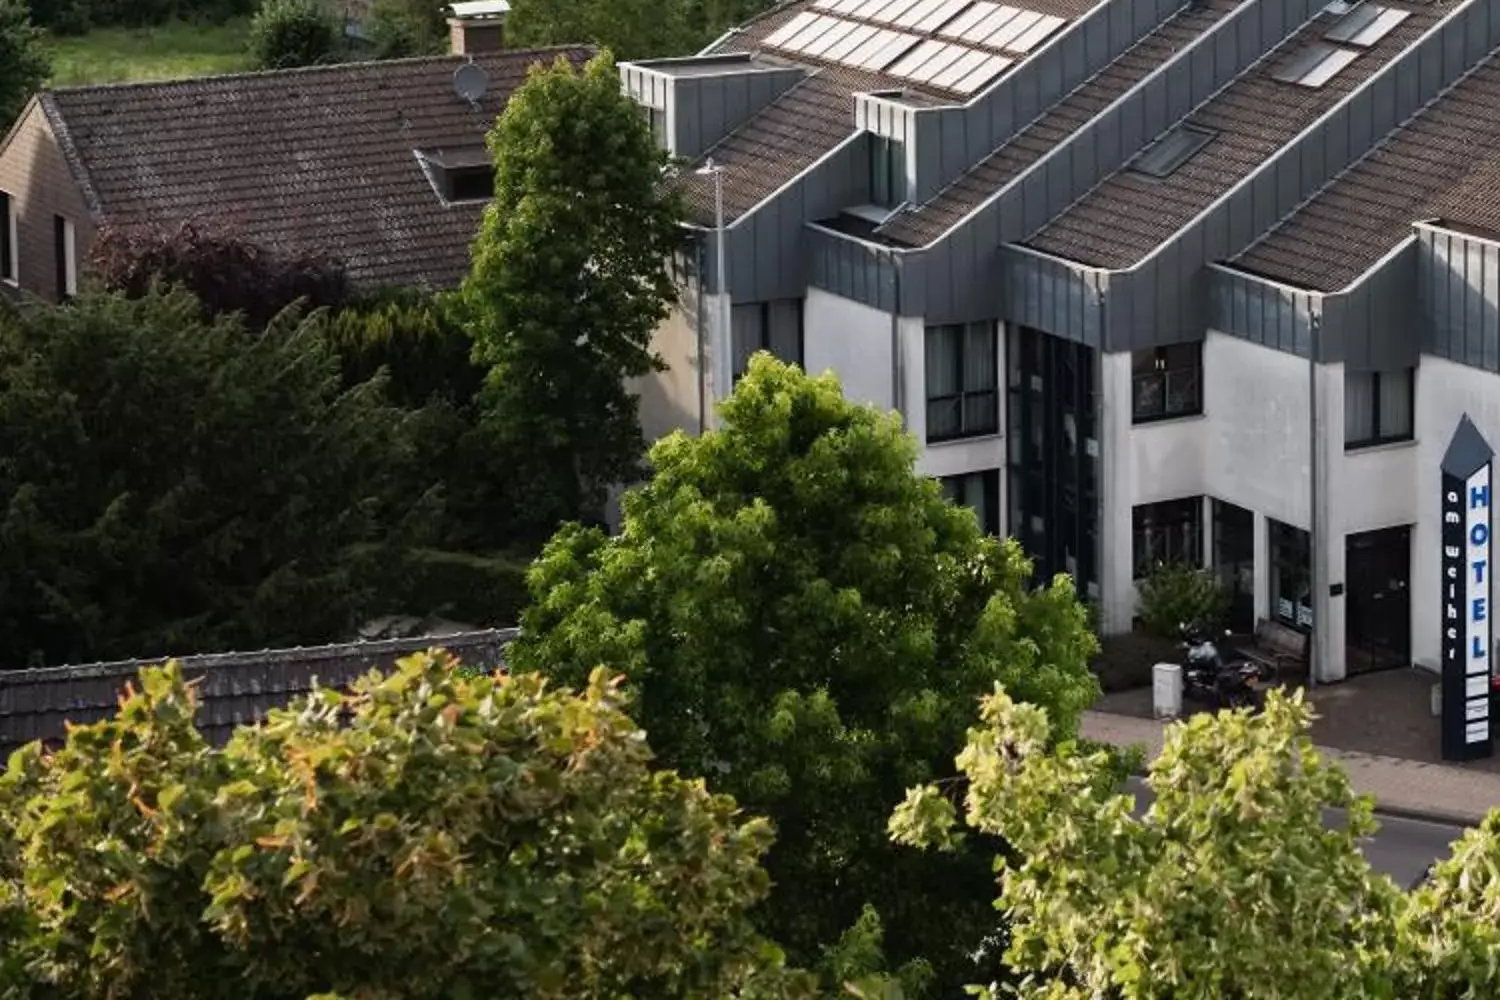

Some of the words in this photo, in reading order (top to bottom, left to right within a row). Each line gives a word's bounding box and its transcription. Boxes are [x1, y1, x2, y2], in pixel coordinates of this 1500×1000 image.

[1445, 491, 1459, 525] am
[1445, 546, 1459, 659] weiher
[1469, 486, 1488, 658] HOTEL
